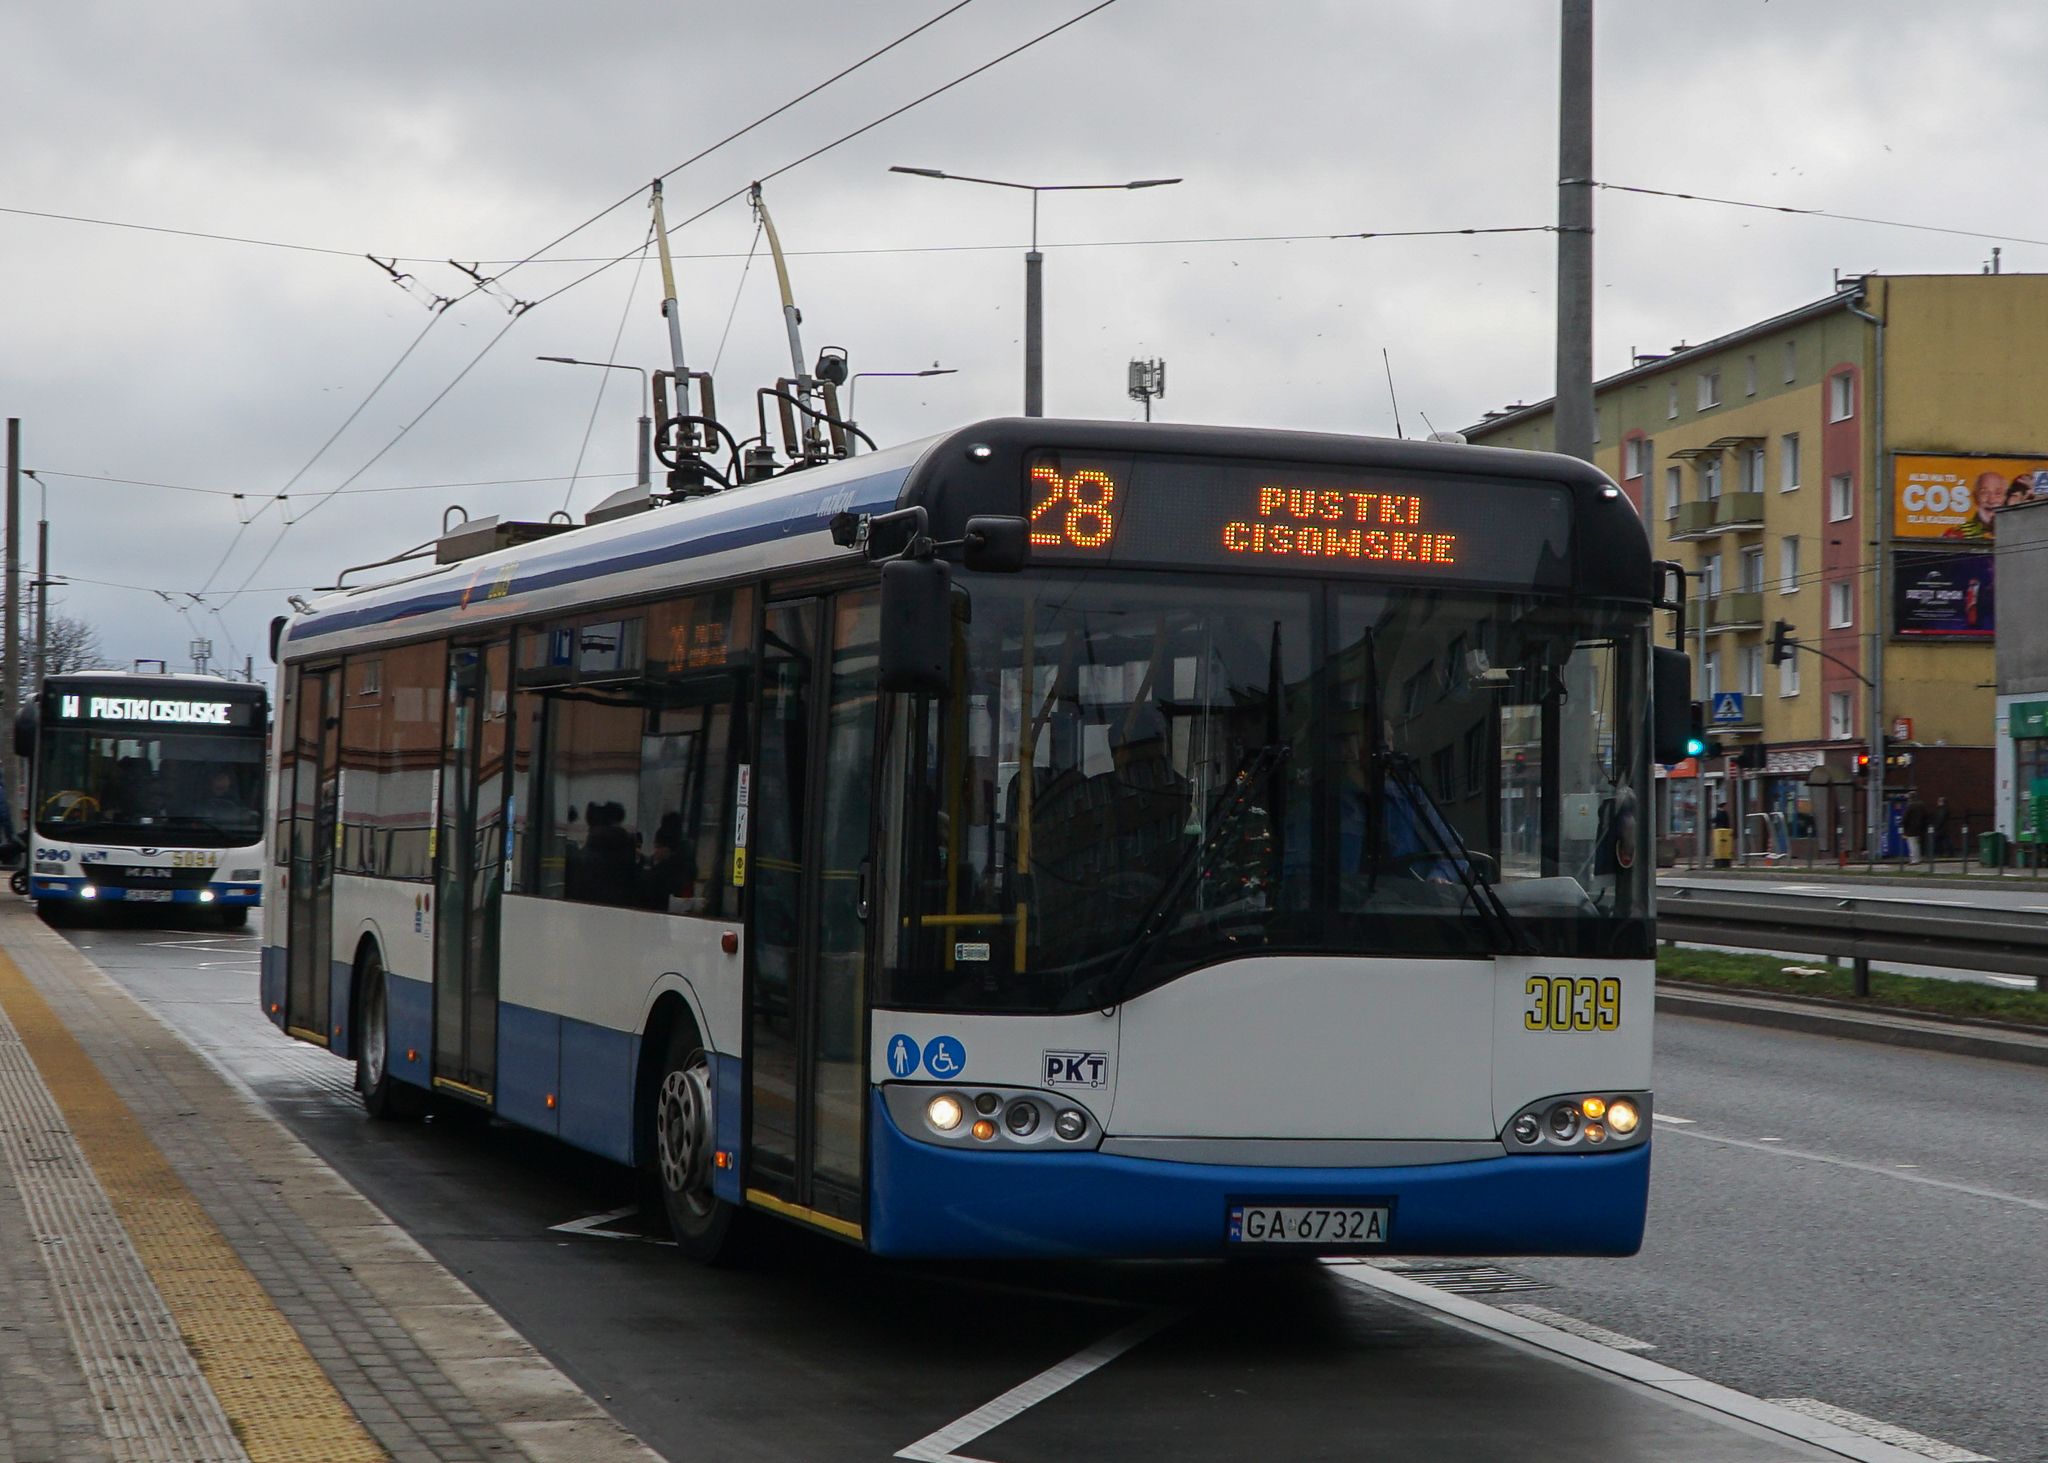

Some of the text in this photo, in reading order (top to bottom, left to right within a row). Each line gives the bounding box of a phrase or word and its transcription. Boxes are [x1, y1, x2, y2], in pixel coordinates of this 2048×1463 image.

[1031, 468, 1114, 547] 28
[1258, 487, 1421, 525] PUSTKI
[1902, 479, 1972, 513] COŚ
[1223, 521, 1457, 564] CISOWSKIE
[90, 697, 149, 721] PUSTKI
[125, 867, 173, 878] MAN
[1524, 975, 1621, 1032] 3039
[1047, 1053, 1104, 1081] PKT
[1247, 1210, 1382, 1239] GA 6732A
